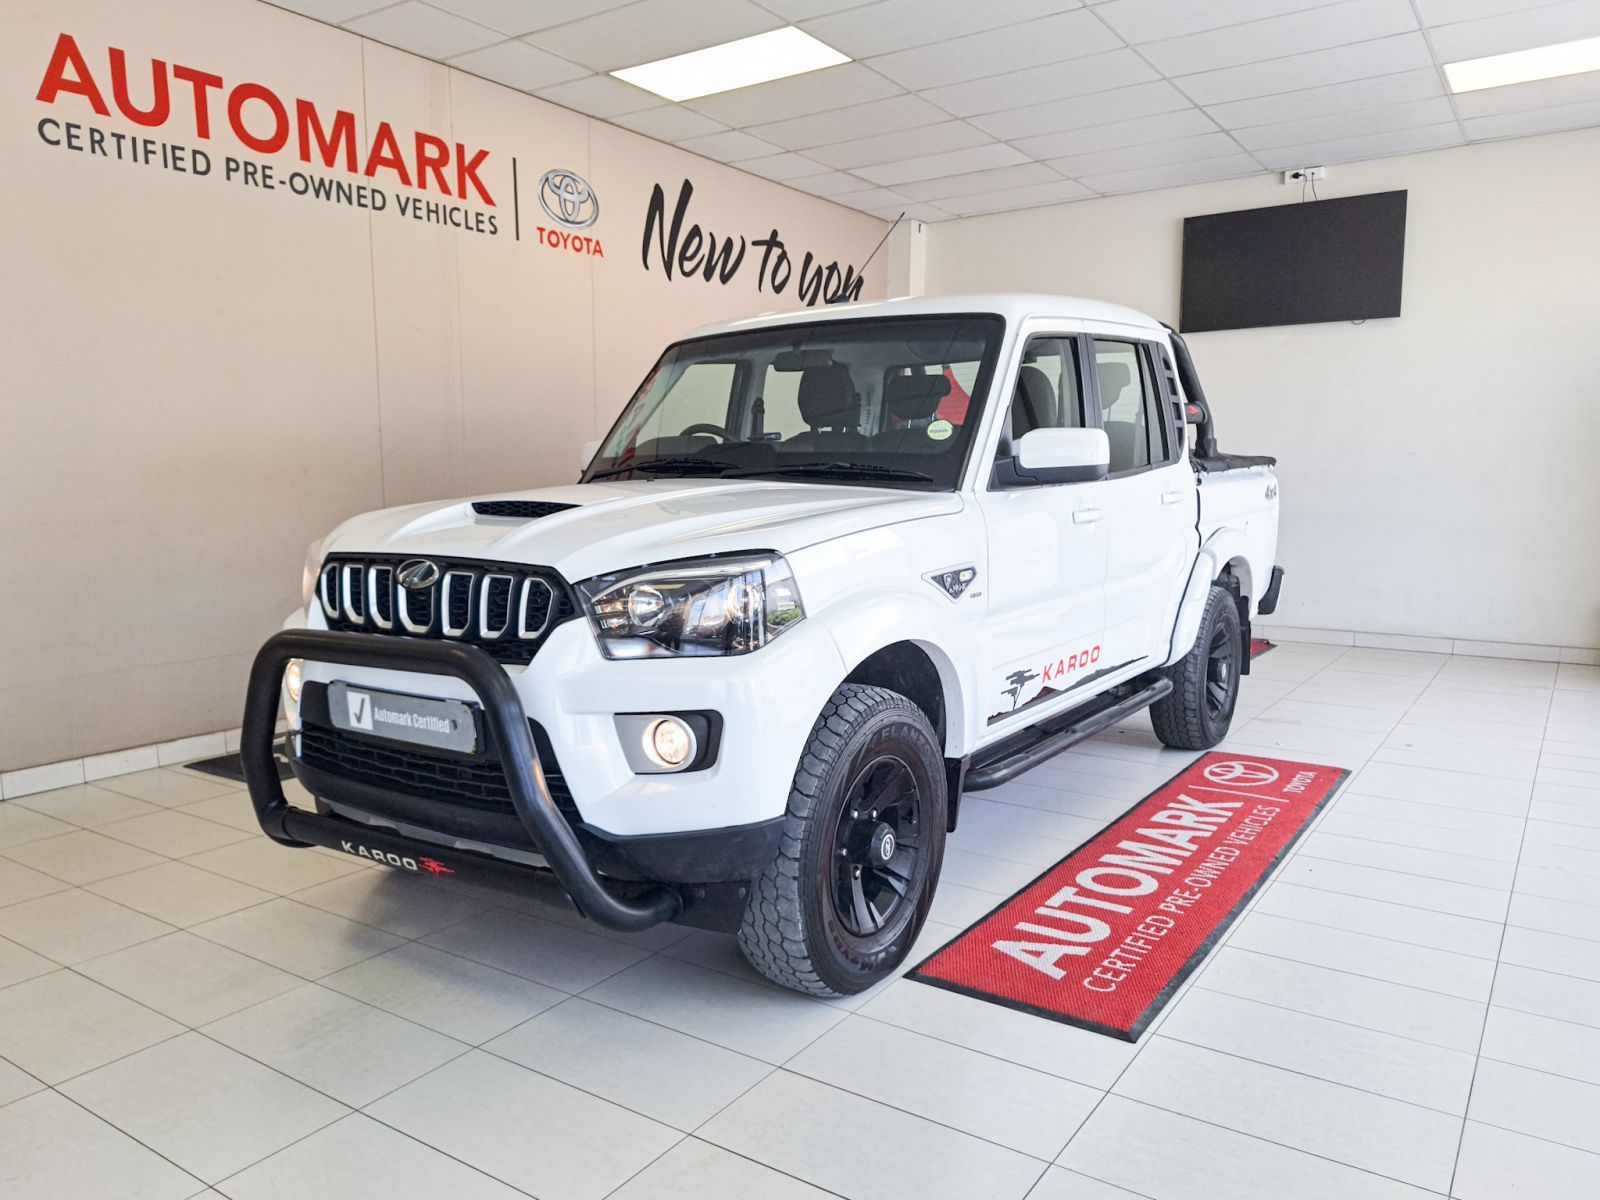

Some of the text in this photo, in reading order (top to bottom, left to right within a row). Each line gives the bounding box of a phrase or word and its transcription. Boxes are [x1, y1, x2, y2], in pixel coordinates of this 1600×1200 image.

[35, 33, 497, 207] AUTOMARK
[38, 118, 498, 235] CERTIFIED PRE-OWNED VEHICLES
[536, 226, 604, 258] TOYOTA
[642, 178, 746, 285] New
[751, 229, 791, 295] to
[1042, 645, 1101, 683] KAROO
[374, 706, 450, 733] Automark Certified
[1282, 770, 1318, 794] TOYOTA
[341, 840, 418, 871] KAROO
[991, 793, 1245, 981] AUTOMARK
[1083, 804, 1281, 992] CERTIFIED PRE-OWNED VEHICLES
